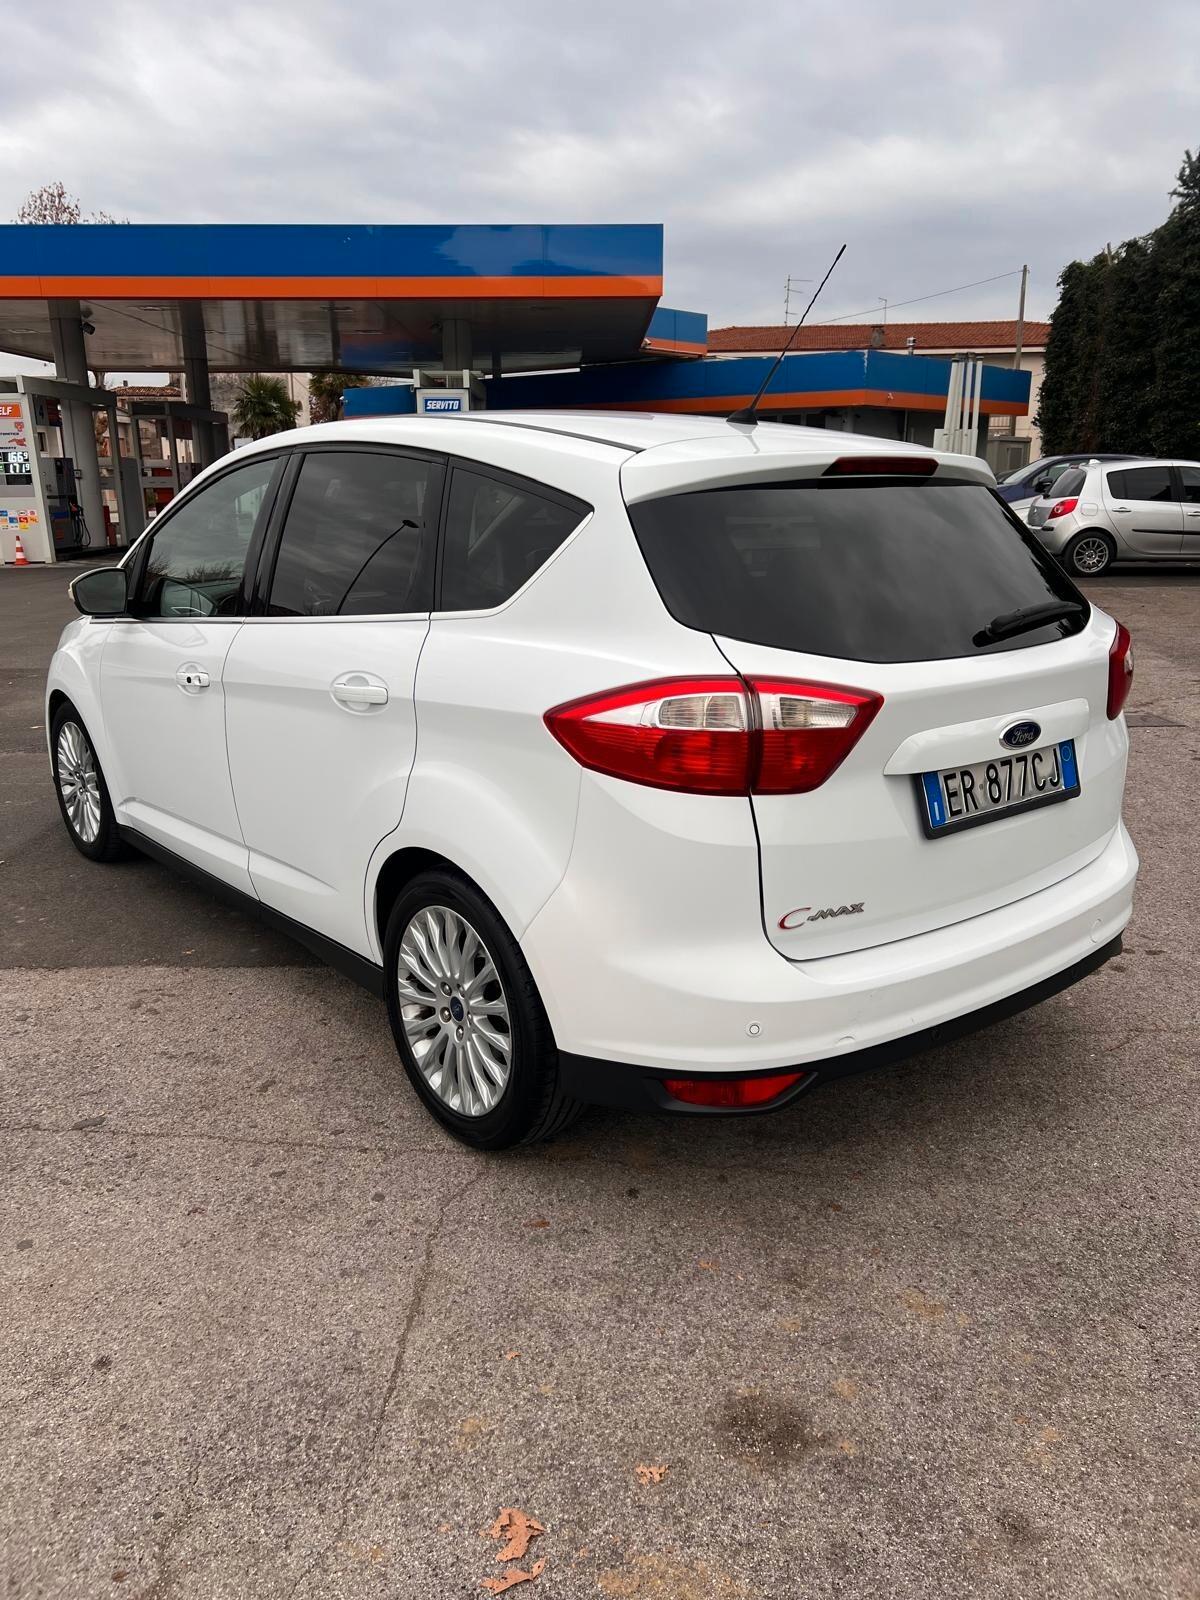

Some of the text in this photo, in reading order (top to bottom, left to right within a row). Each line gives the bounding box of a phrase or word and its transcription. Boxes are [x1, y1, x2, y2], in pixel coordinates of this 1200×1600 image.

[426, 400, 459, 410] SERVITO
[1011, 727, 1035, 744] Ford
[943, 748, 1061, 817] ER 877CJ
